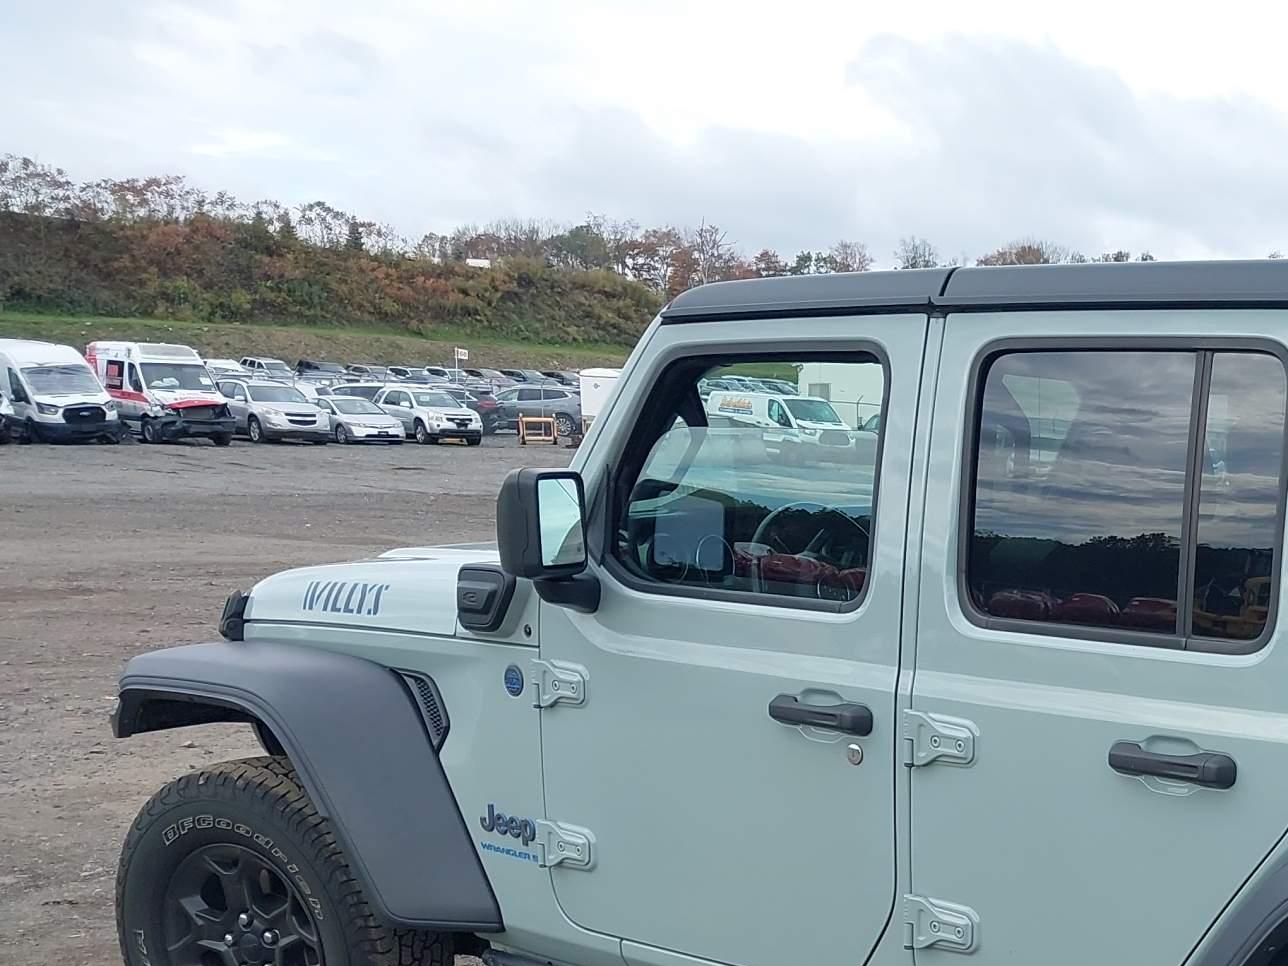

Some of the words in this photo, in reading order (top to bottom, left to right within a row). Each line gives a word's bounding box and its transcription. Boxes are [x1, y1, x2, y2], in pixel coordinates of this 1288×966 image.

[302, 580, 391, 616] WILLYS
[479, 803, 537, 847] Jeep
[162, 815, 324, 921] BFGoodrich
[480, 841, 531, 861] WRANGLER
